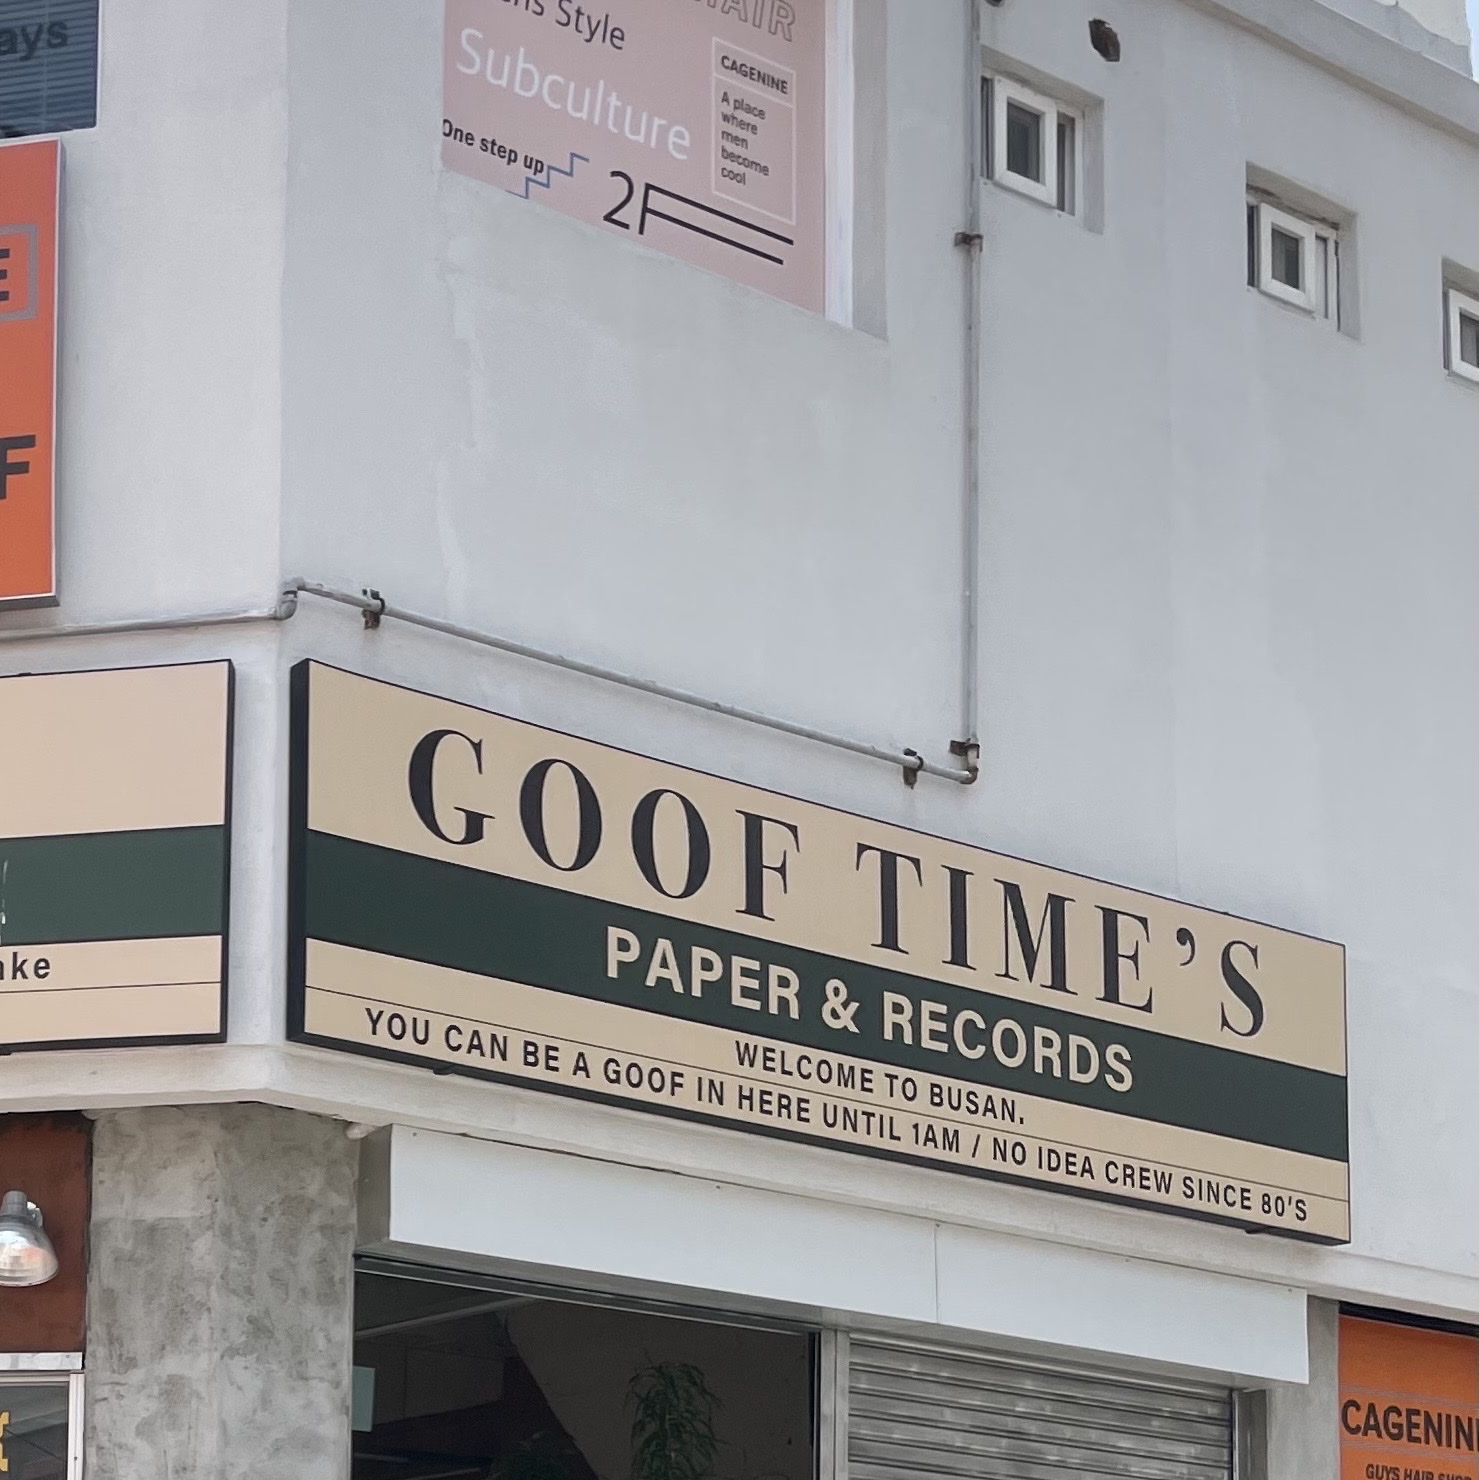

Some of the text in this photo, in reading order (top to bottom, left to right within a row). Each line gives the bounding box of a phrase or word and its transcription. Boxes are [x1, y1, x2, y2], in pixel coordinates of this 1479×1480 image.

[555, 0, 625, 50] Style
[456, 27, 691, 160] Subculture
[720, 55, 788, 95] CAGENINE
[720, 91, 766, 120] A place
[720, 111, 758, 135] where
[442, 118, 545, 177] One step up
[720, 130, 749, 150] men
[720, 145, 769, 176] become
[720, 167, 746, 185] cool
[603, 170, 795, 266] 2F
[408, 728, 1265, 1038] GOOF TIME’S
[606, 925, 1134, 1093] PAPER & RECORDS
[735, 1039, 1025, 1126] WELCOME TO BUSAN.
[364, 1006, 1309, 1223] YOU CAN BE A GOOF IN HERE UNTIL 1AM / NO IDEA CREW SINCE 80'S
[1341, 1399, 1479, 1453] CAGENIN
